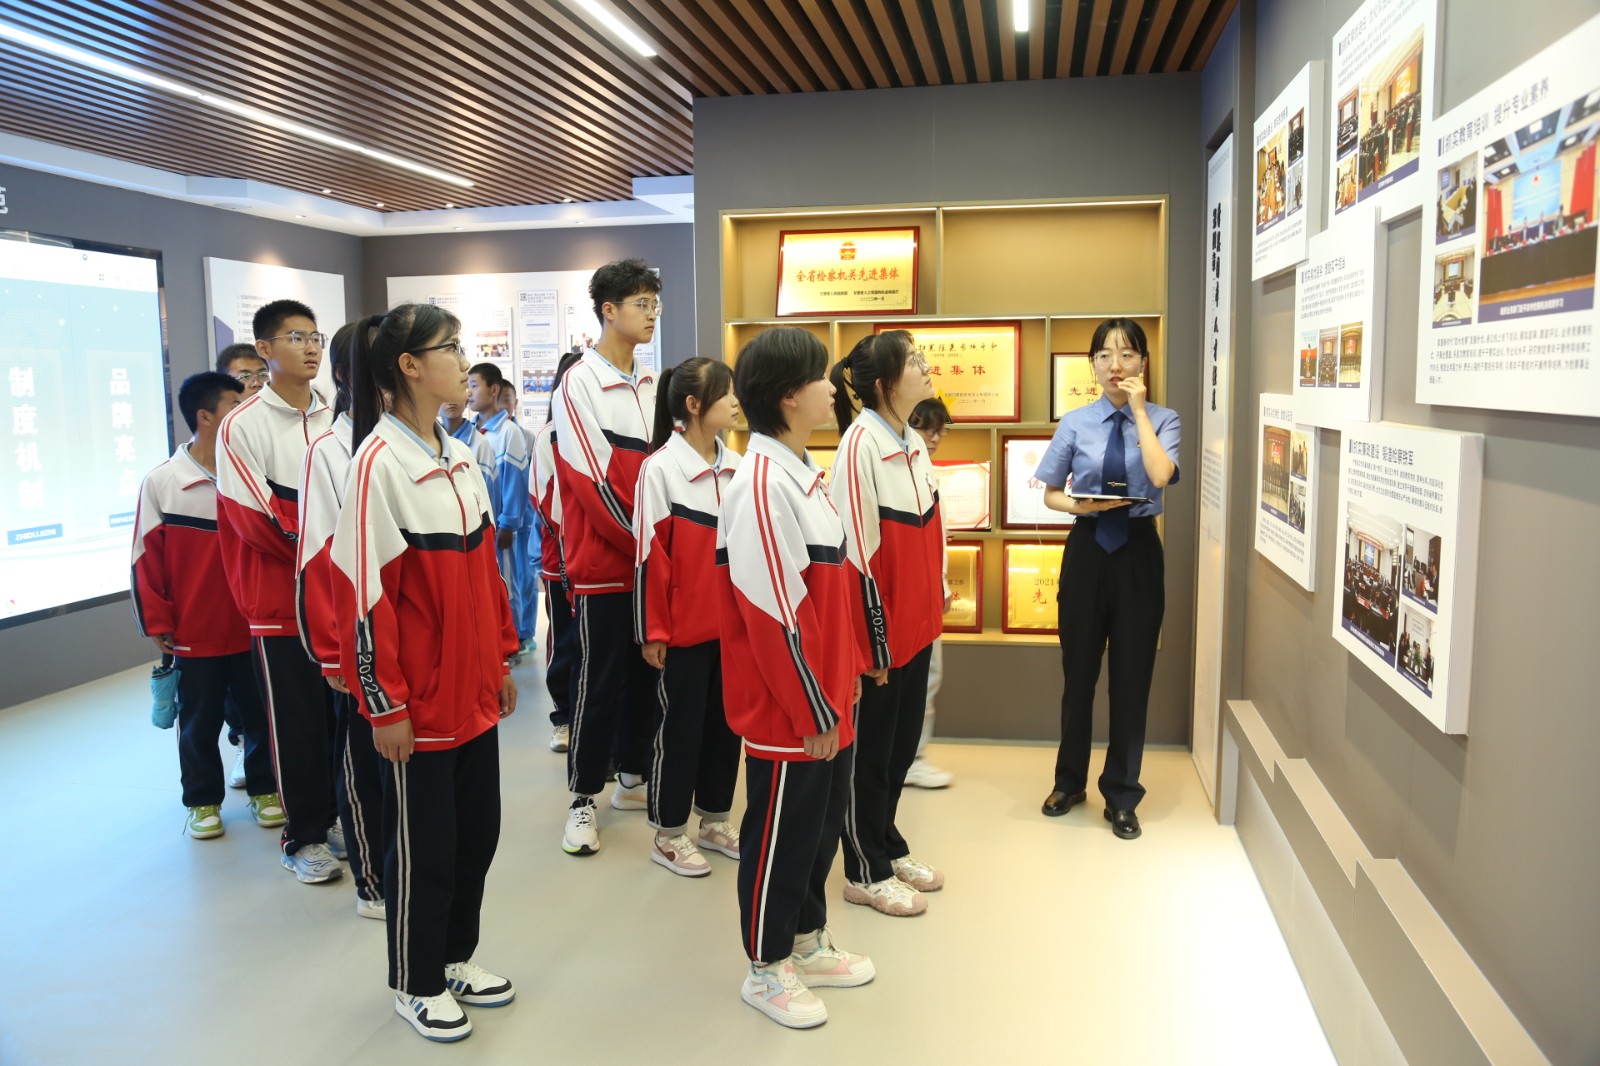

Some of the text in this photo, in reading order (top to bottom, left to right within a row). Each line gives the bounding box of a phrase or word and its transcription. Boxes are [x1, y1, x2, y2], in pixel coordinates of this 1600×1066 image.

[796, 266, 900, 283] 全省检察机关先进集体
[1034, 578, 1060, 586] 2021
[870, 608, 886, 644] 2022
[358, 654, 379, 697] 2022
